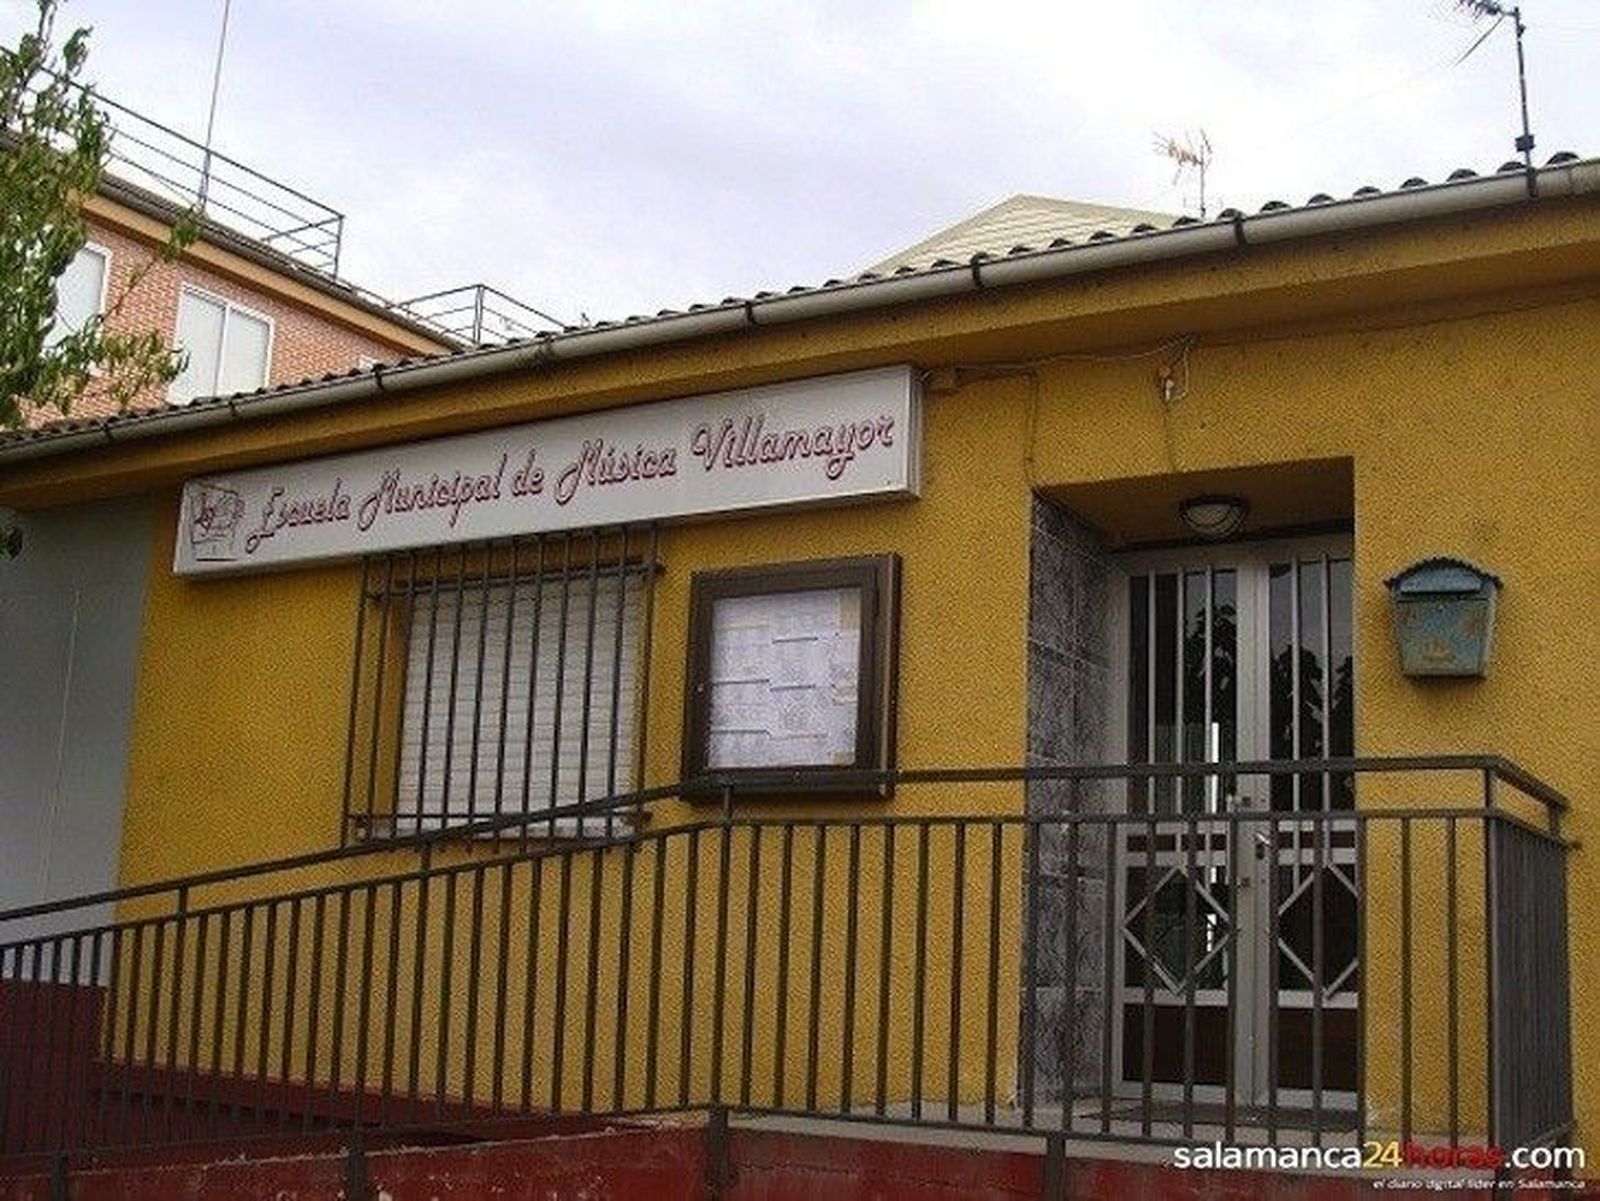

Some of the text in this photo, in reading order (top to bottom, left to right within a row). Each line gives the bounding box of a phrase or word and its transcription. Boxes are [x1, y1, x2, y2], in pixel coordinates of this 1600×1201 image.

[246, 413, 894, 552] Escuela Municipal de Música Villamayor
